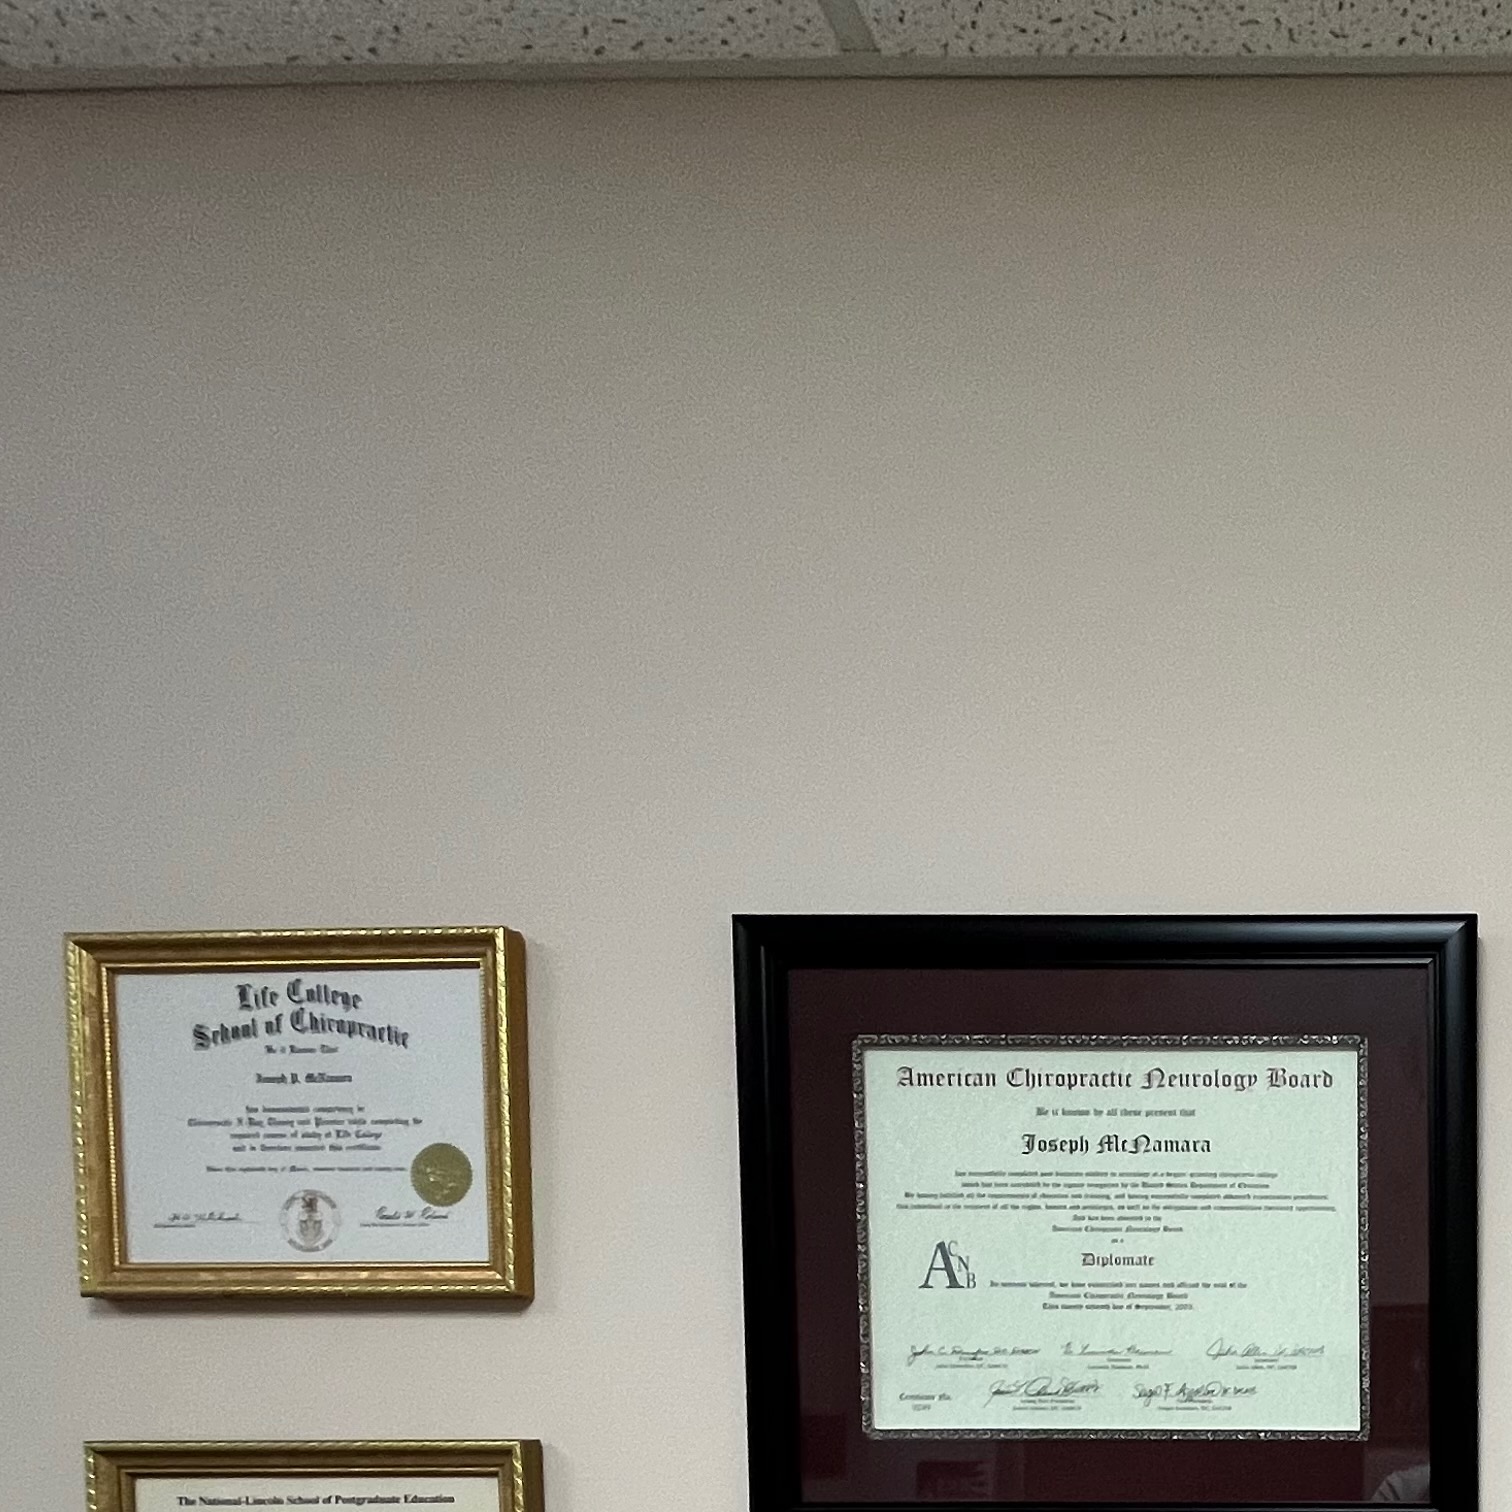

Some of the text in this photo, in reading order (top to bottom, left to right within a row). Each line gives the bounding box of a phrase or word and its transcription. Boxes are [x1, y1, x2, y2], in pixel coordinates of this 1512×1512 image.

[236, 978, 362, 1014] Life College
[193, 1006, 409, 1050] School of Chiropractic
[897, 1066, 1332, 1091] American Chiropractic Neurology Board
[1022, 1134, 1210, 1154] Joseph McNamara
[1081, 1253, 1154, 1267] Diplomate
[177, 1497, 196, 1506] The
[286, 1496, 320, 1505] School
[322, 1495, 332, 1504] of
[404, 1494, 455, 1503] Education
